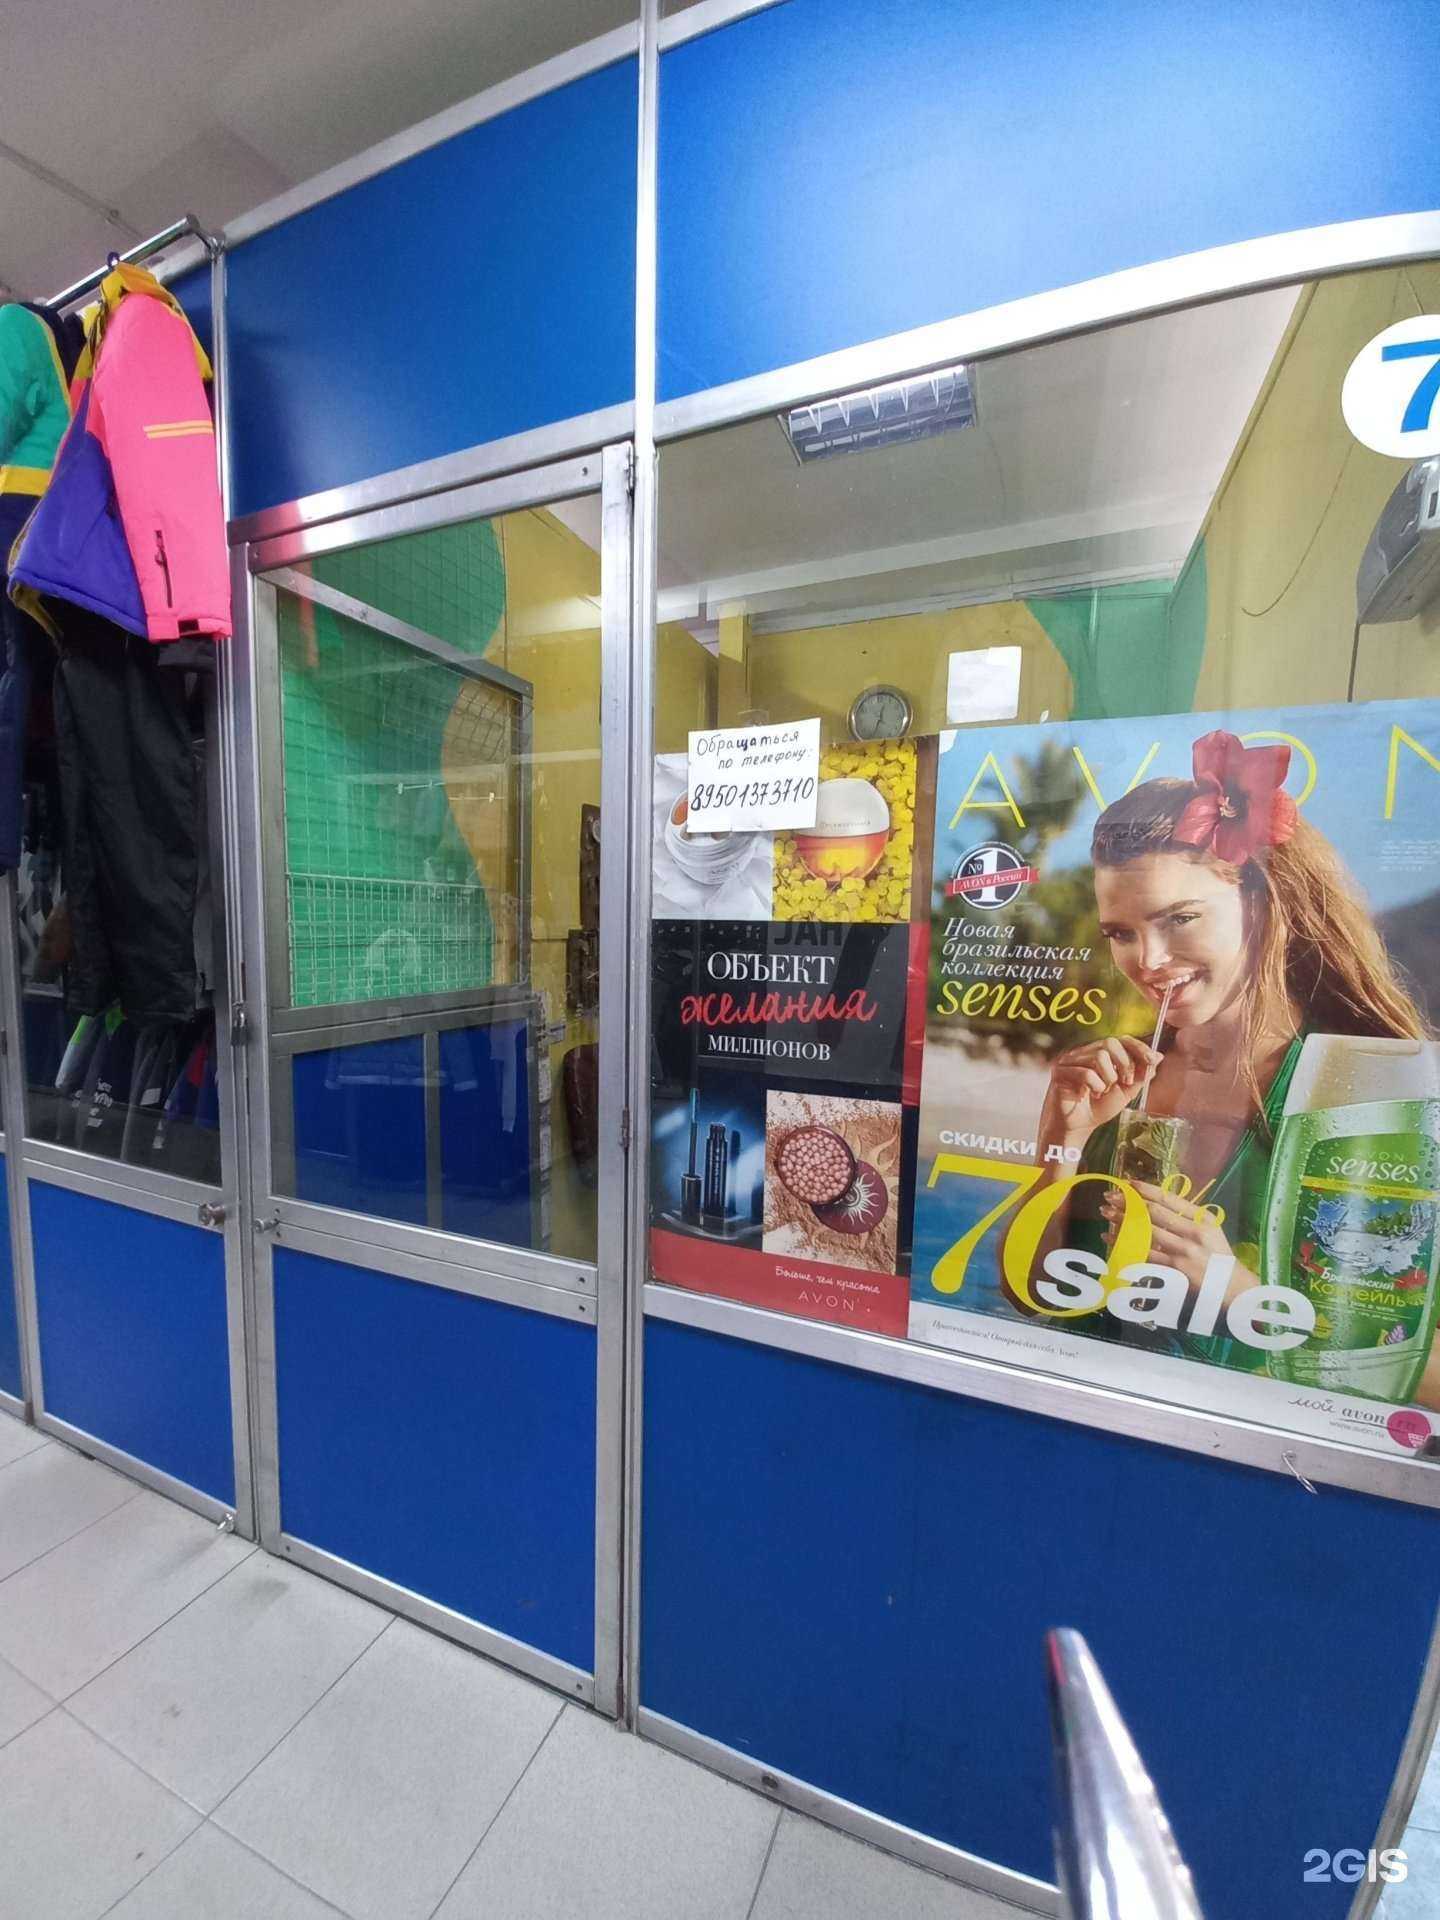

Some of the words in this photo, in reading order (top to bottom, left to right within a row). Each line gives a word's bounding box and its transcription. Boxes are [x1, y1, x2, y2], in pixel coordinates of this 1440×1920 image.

[697, 730, 800, 757] Обращаться
[718, 758, 734, 770] по
[690, 777, 815, 811] 89501373710
[942, 917, 1016, 939] Новая
[942, 936, 1092, 962] бразильская
[706, 951, 835, 985] ОБЪЕКТ
[940, 960, 1065, 985] коллекция
[680, 988, 878, 1026] желания
[936, 980, 1107, 1026] senses
[939, 1129, 1037, 1157] скидки
[1044, 1141, 1083, 1164] до
[1326, 1155, 1420, 1184] senses
[798, 1290, 854, 1312] AVON
[1036, 1246, 1317, 1353] sale
[1309, 1278, 1407, 1308] Коейль
[1341, 1407, 1386, 1425] avon
